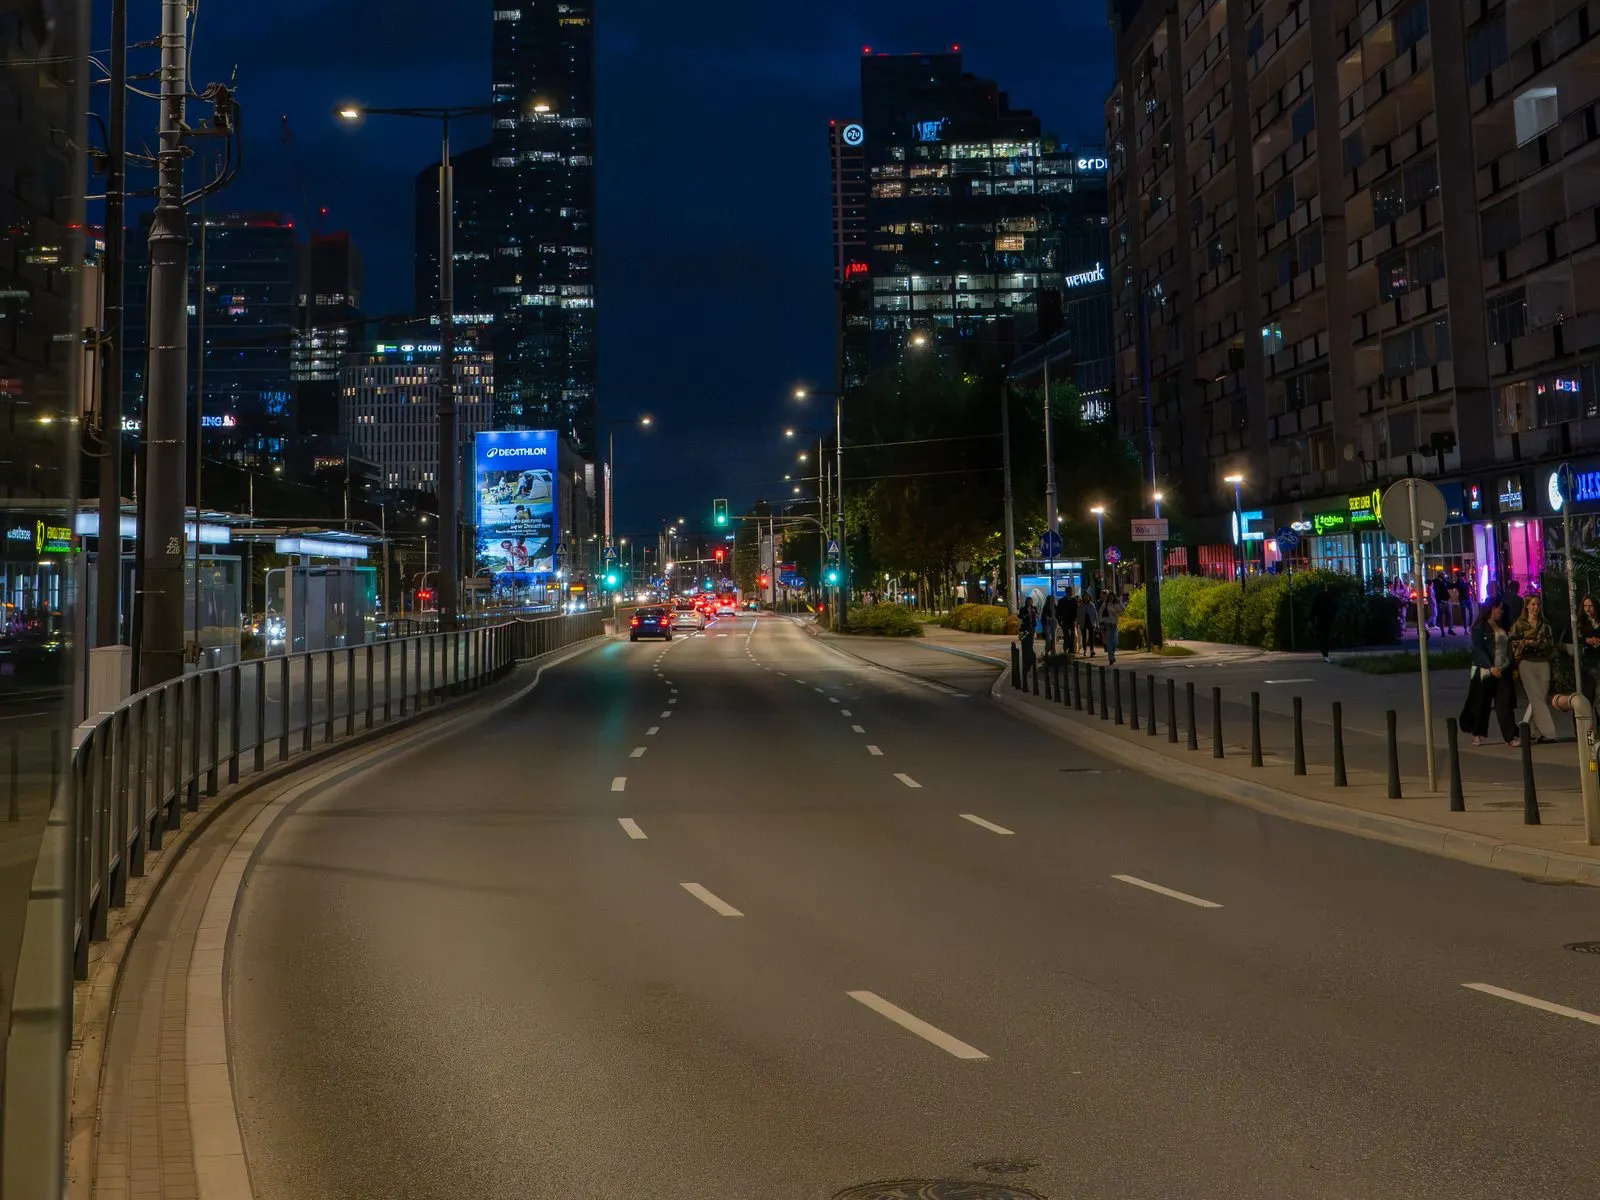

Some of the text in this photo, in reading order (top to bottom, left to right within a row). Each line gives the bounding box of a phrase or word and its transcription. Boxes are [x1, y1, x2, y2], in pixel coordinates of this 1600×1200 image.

[1065, 262, 1105, 288] wework
[202, 416, 222, 427] ING
[498, 447, 547, 456] DECATHLON
[169, 536, 179, 546] 25
[166, 545, 180, 555] 226
